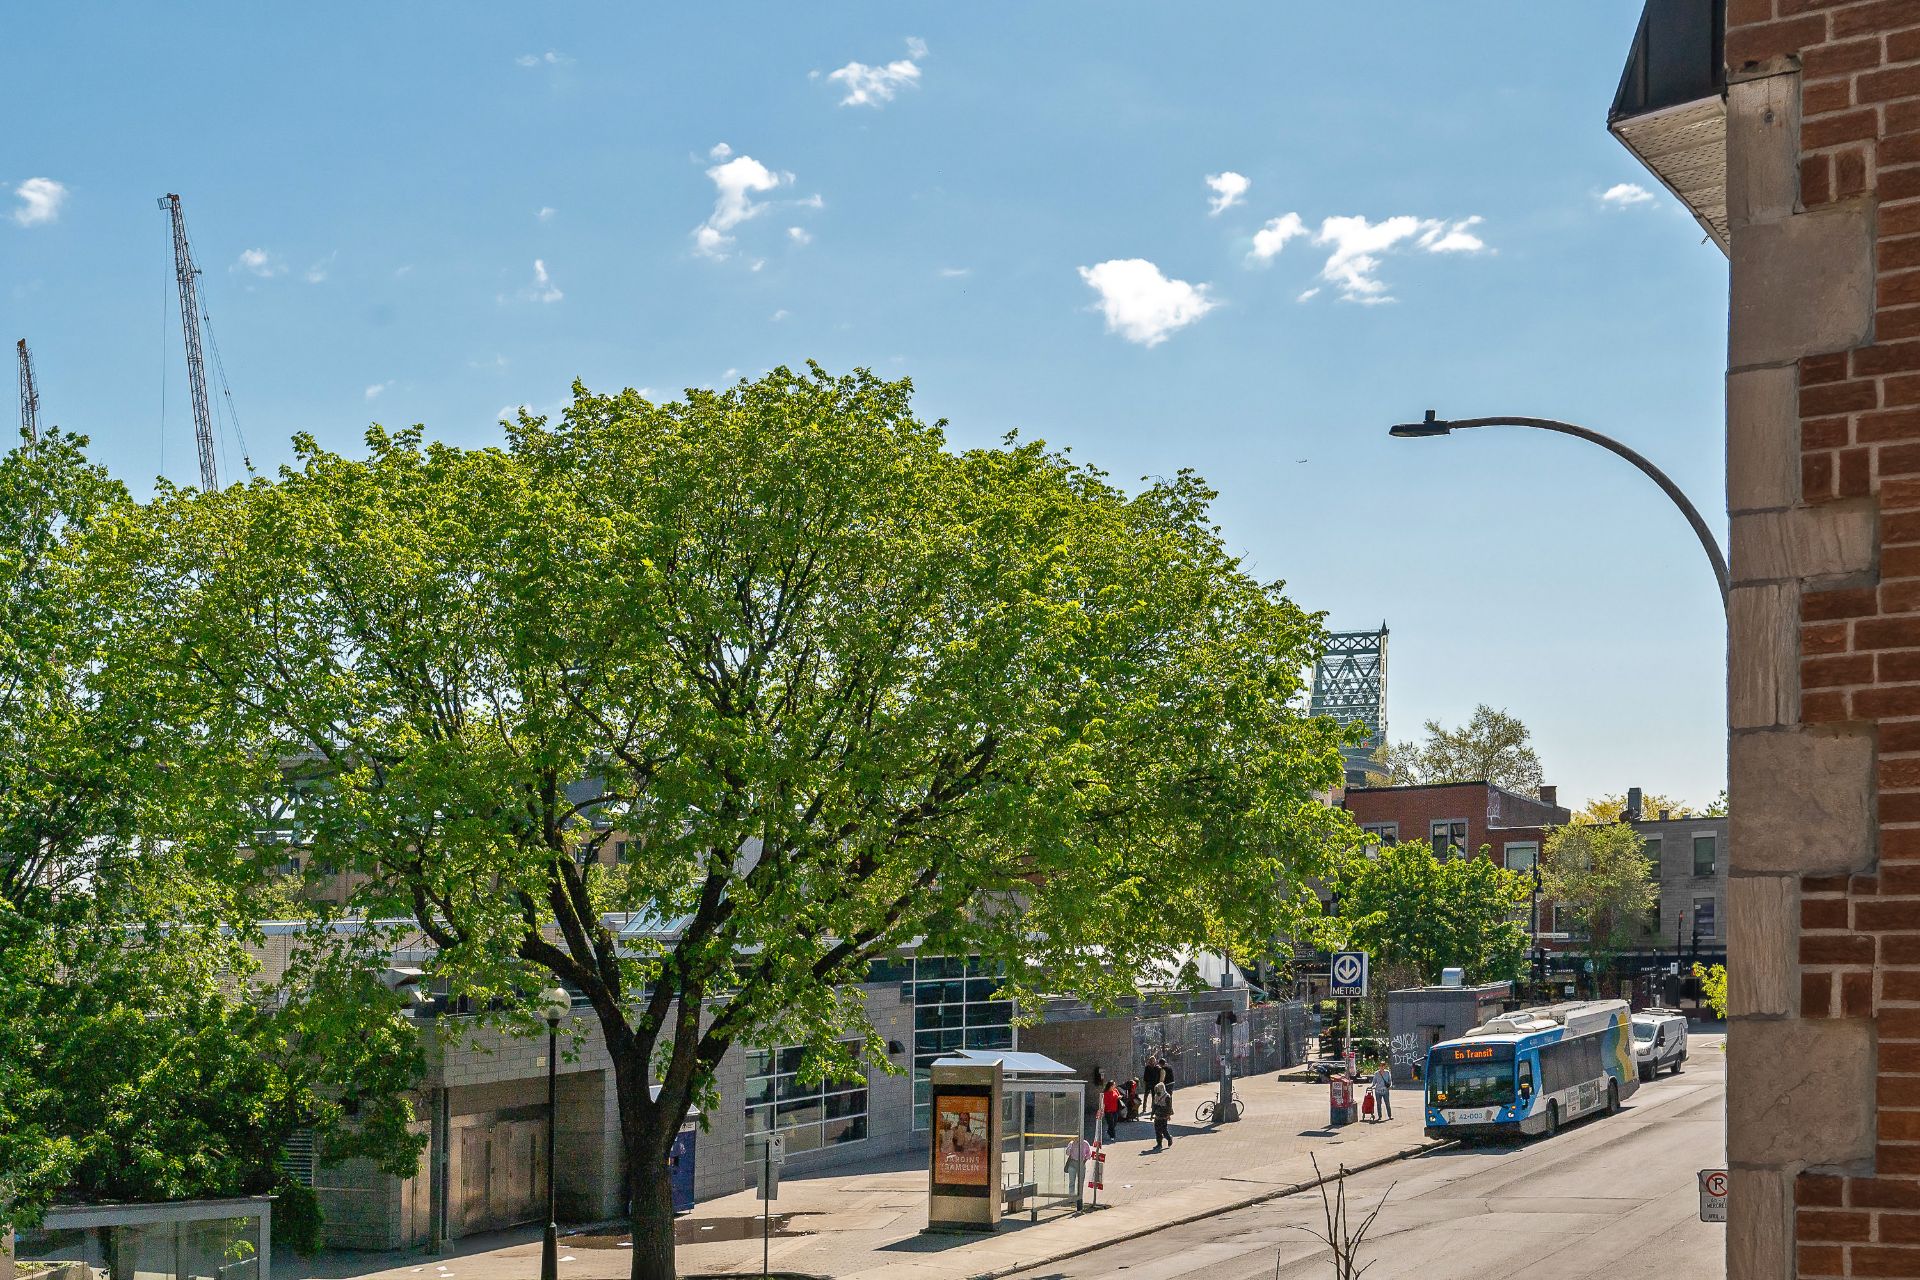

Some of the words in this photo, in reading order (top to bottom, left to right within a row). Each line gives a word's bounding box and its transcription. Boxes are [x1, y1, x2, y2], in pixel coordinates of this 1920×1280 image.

[1332, 986, 1361, 995] METRO
[1454, 1050, 1465, 1059] En
[1466, 1047, 1493, 1059] Transit
[1458, 1112, 1483, 1120] 42-003
